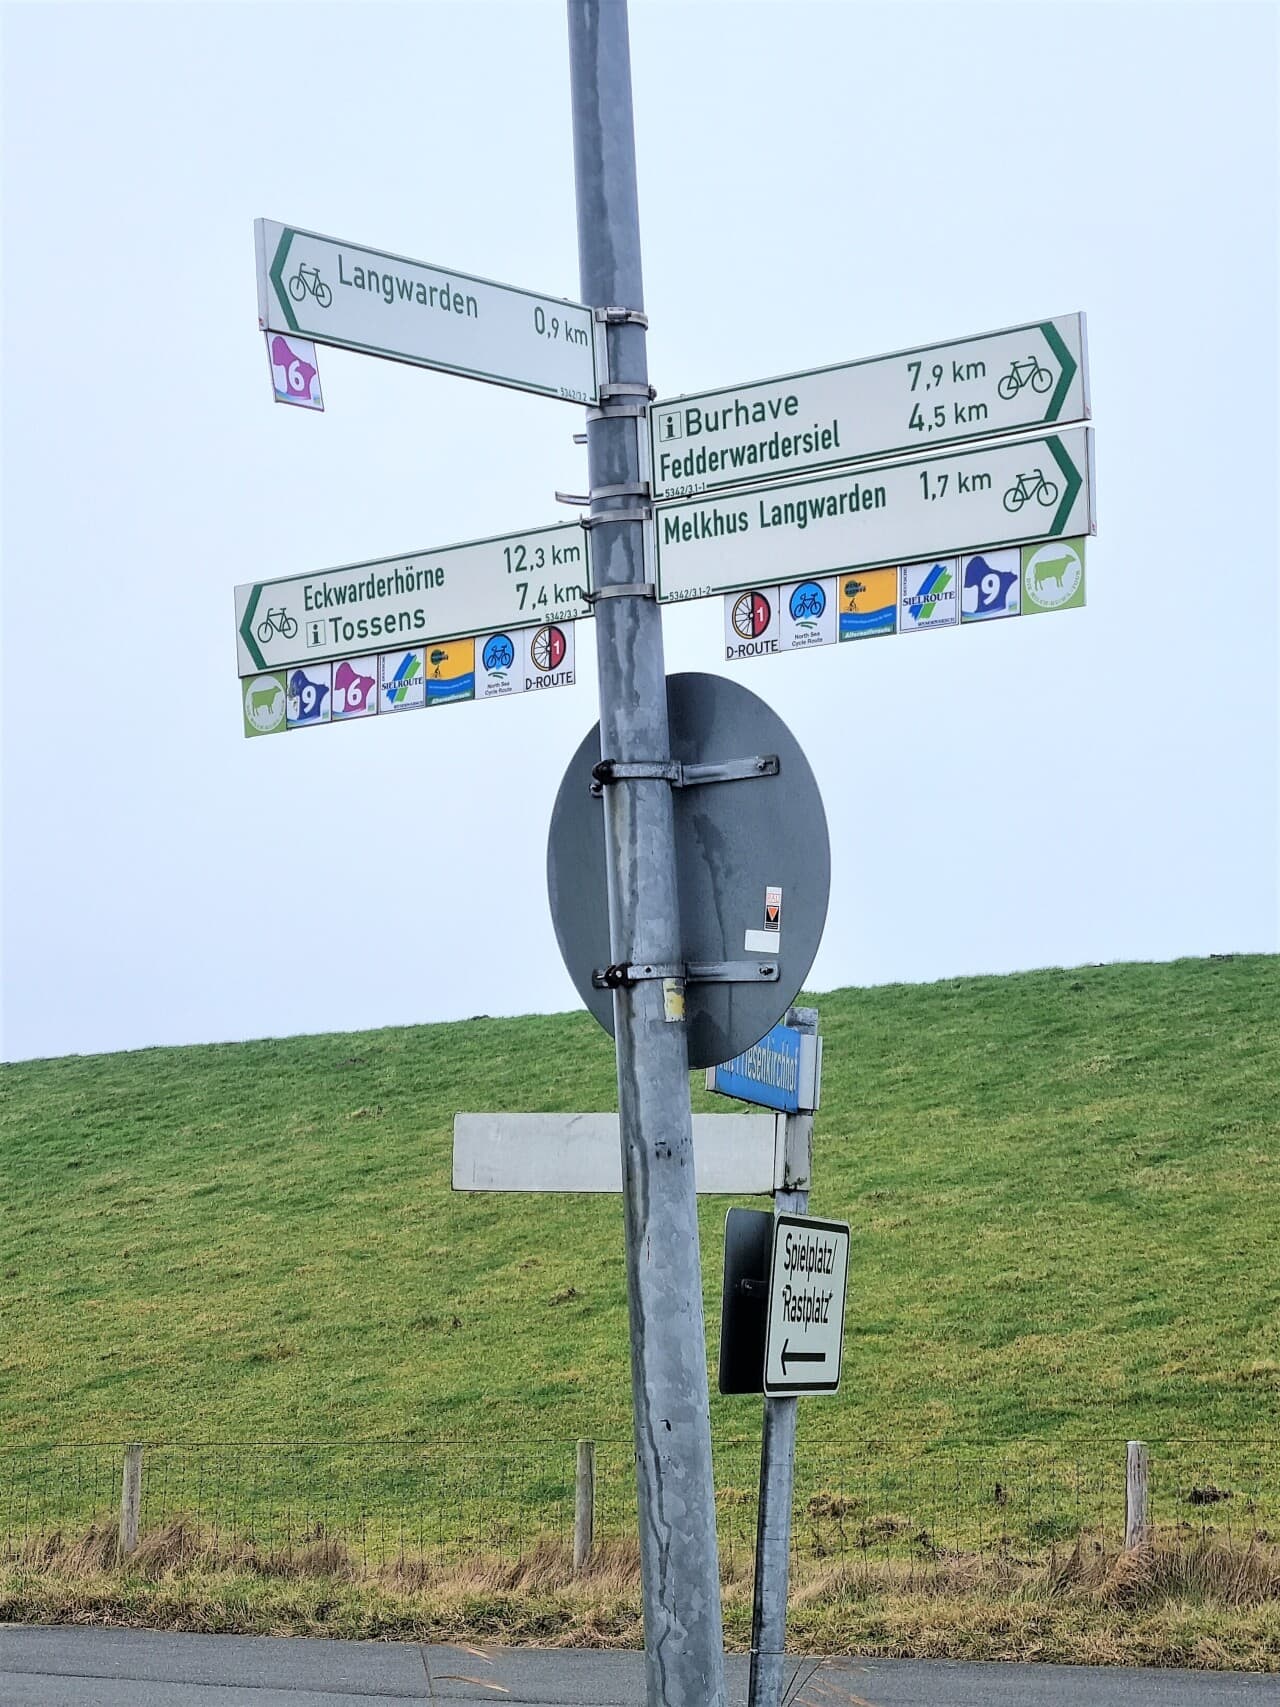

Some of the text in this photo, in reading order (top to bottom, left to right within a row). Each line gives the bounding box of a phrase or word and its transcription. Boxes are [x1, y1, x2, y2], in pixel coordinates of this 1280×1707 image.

[338, 254, 588, 346] Langwarden 0,9 km
[288, 360, 303, 387] 6
[685, 393, 799, 437] Burhave
[907, 361, 943, 391] 7,9
[952, 360, 986, 383] km
[660, 402, 988, 482] Fedderwardersiel 4,5 km
[664, 471, 992, 545] Melkhus Langwarden 1,7 km
[304, 545, 580, 611] Eckwarderhörne 12,3 km
[981, 573, 1001, 606] 9
[329, 608, 426, 643] Tossens
[516, 583, 549, 610] 7,4
[554, 583, 585, 605] km
[756, 606, 764, 622] 1
[903, 591, 956, 607] SIELROUTE
[553, 640, 561, 656] 1
[726, 639, 779, 659] D-ROUTE
[347, 677, 363, 707] 6
[525, 671, 574, 691] D-ROUTE
[301, 685, 317, 714] 9
[783, 1231, 838, 1283] Spielplatz/
[783, 1284, 831, 1334] Rastplatz
